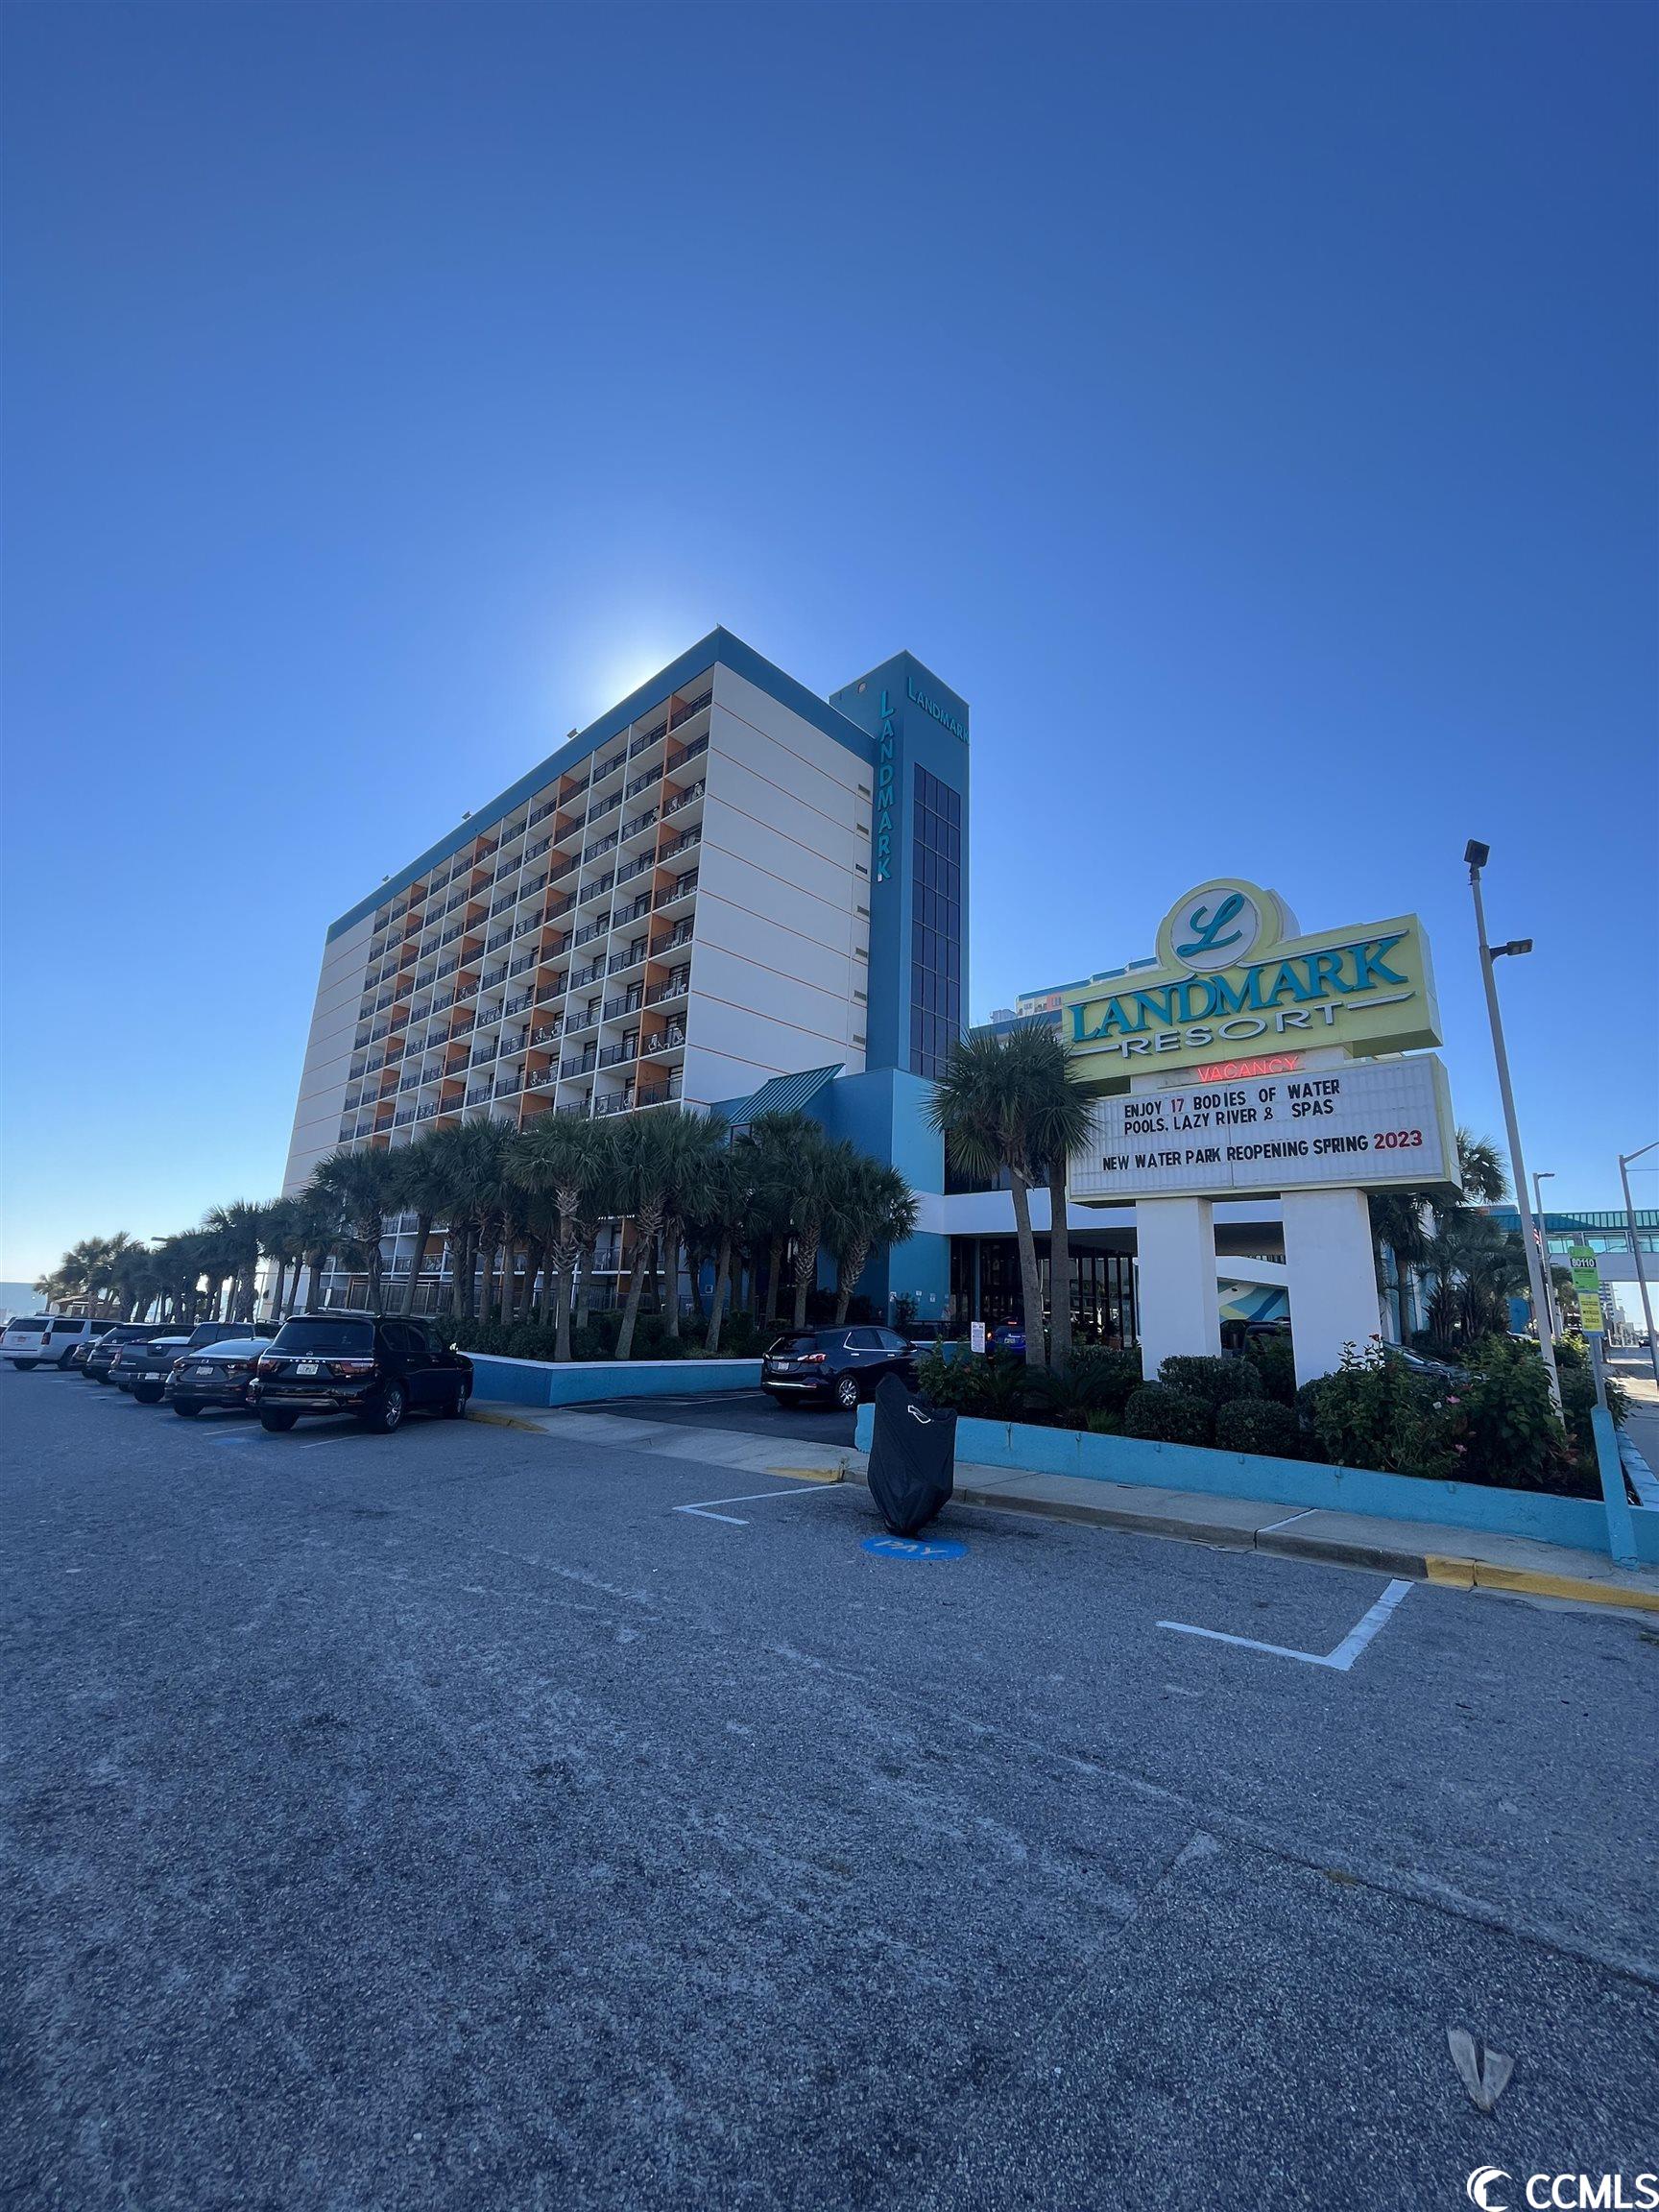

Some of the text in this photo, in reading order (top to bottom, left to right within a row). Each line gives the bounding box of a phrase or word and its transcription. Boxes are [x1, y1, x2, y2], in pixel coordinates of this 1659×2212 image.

[907, 677, 969, 745] LANDMARK
[878, 690, 895, 879] LANDMARK
[1177, 893, 1245, 958] L
[1067, 937, 1408, 1043] LANDMARK
[1120, 1001, 1344, 1059] RESORT
[1197, 1056, 1298, 1083] VACANCY
[1124, 1079, 1340, 1118] ENJOY 17 BODIES OF WATER
[1173, 1113, 1210, 1131] LAZY
[1215, 1108, 1257, 1125] RIVER
[1263, 1107, 1273, 1121] &
[1291, 1099, 1334, 1118] SPAS
[1102, 1130, 1423, 1170] NEW WATER PARK REOPENING SPRING 2023
[874, 1540, 949, 1555] PAY
